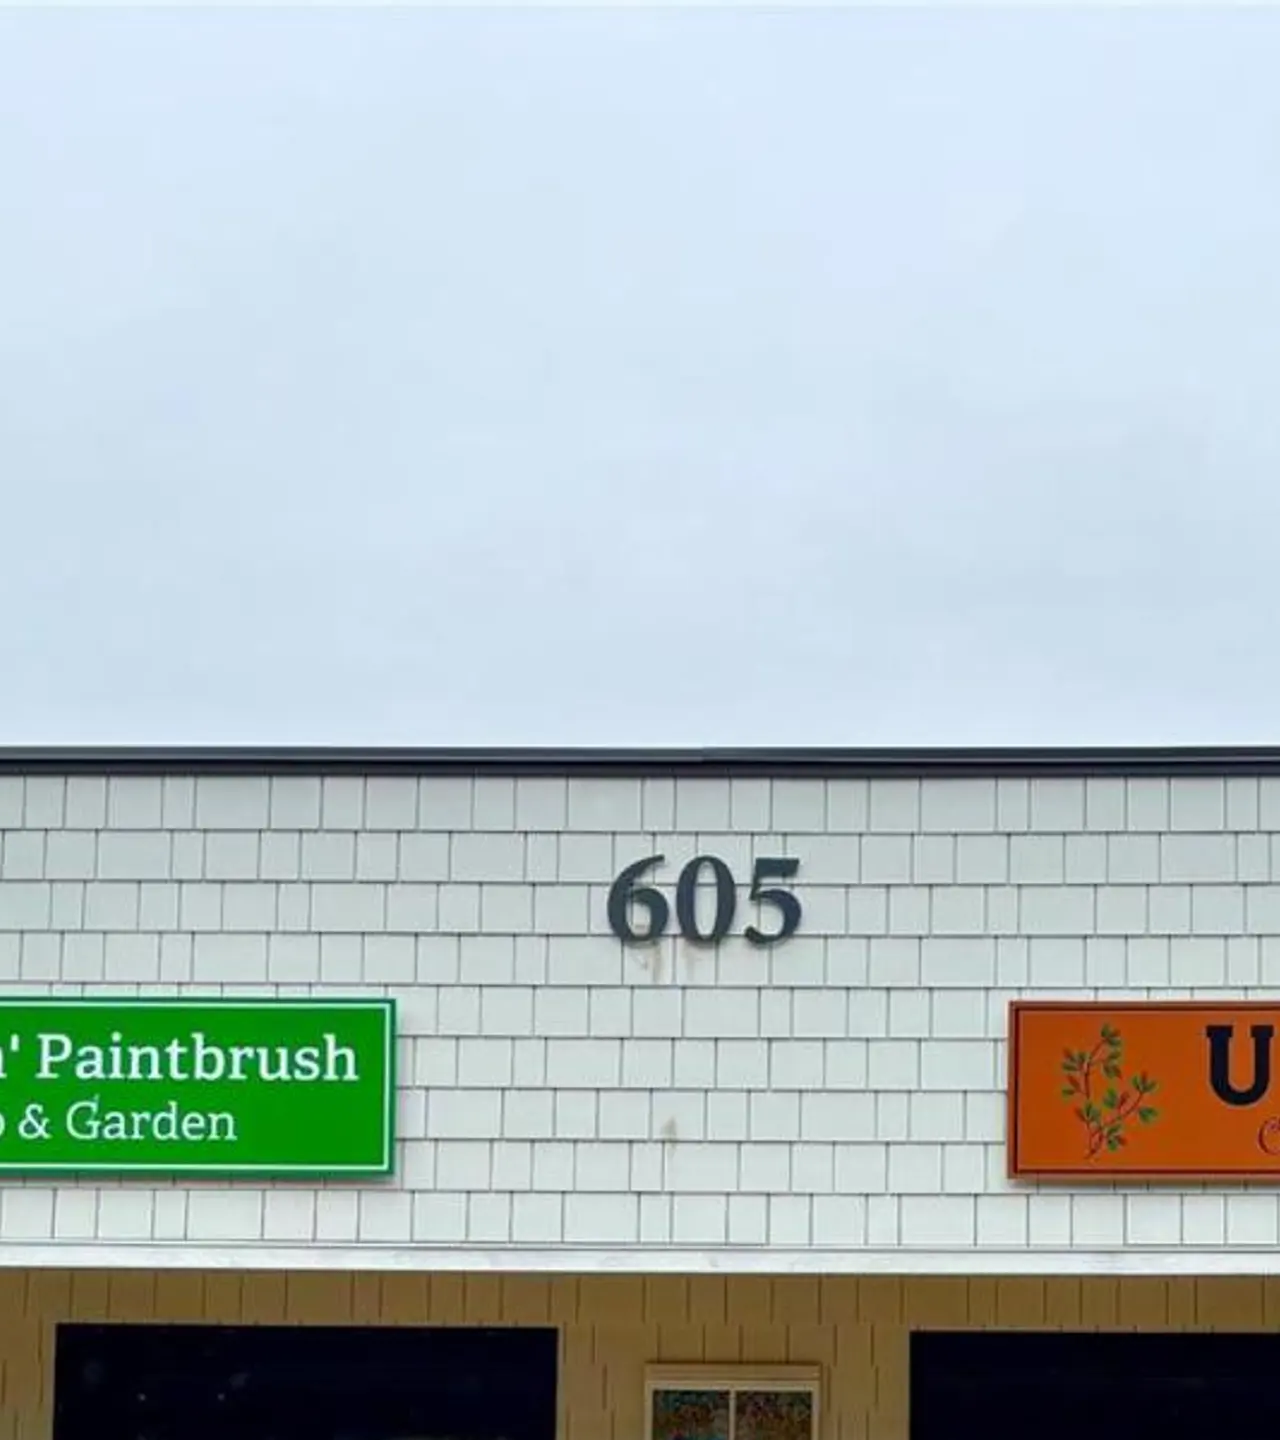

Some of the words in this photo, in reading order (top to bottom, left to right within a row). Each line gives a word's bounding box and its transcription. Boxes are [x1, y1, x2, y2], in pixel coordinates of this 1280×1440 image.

[607, 854, 802, 944] 605
[34, 1031, 360, 1082] Paintbrush
[17, 1102, 53, 1140] &
[65, 1095, 238, 1141] Garden
